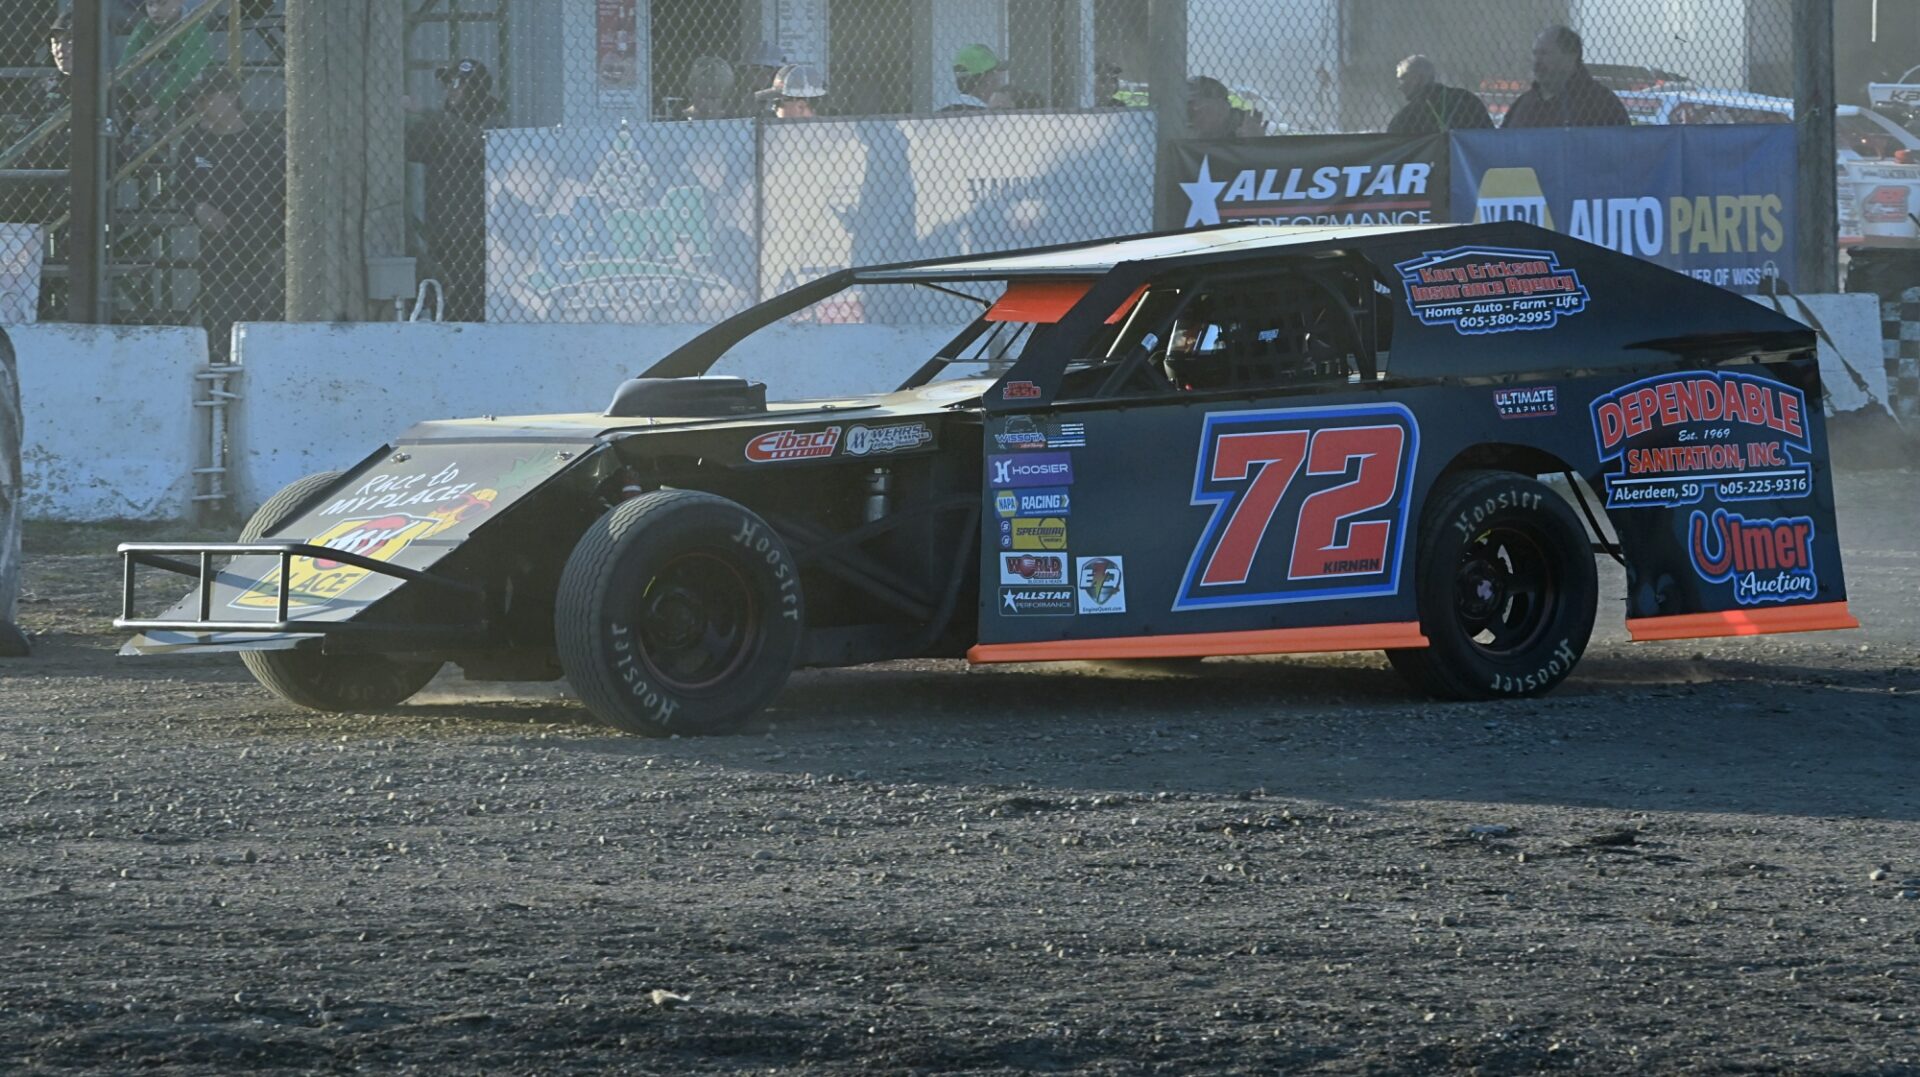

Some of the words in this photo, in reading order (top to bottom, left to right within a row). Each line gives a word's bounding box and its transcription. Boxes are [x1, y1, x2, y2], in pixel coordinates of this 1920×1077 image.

[1223, 163, 1431, 202] ALLSTAR
[1569, 197, 1663, 256] AUTO
[1670, 194, 1784, 254] PARTS
[1419, 263, 1468, 283] Kory
[1467, 260, 1548, 280] Erickson
[1714, 268, 1730, 286] OF
[1411, 281, 1505, 302] Insurance
[1505, 275, 1575, 295] Agency
[1425, 306, 1463, 318] Home
[1473, 303, 1503, 314] Auto
[1513, 299, 1547, 311] Farm
[1556, 296, 1579, 307] Life
[1460, 310, 1551, 328] 605-380-2995
[1496, 389, 1554, 405] ULTIMATE
[1501, 403, 1555, 414] GRAPHICS
[1598, 379, 1803, 448] DEPENDABLE
[872, 424, 923, 438] WEHRS
[995, 432, 1046, 444] WISSOTA
[1678, 430, 1698, 442] Est.
[1703, 428, 1731, 440] 1969
[746, 428, 838, 460] Eibach
[1012, 463, 1069, 476] HOOSIER
[1628, 444, 1746, 474] SANITATION,
[1748, 442, 1785, 467] INC.
[427, 462, 459, 487] to
[318, 496, 378, 517] MY
[367, 482, 477, 510] PLACE!
[1614, 484, 1679, 501] Aberdeen,
[1681, 483, 1699, 496] SD
[1720, 478, 1807, 495] 605-225-9316
[997, 496, 1018, 512] NAPA
[1021, 494, 1061, 511] RACING
[1200, 424, 1405, 586] 72
[1454, 489, 1543, 544] Hoosier
[1016, 526, 1065, 537] SPEEDWAY
[1694, 516, 1809, 575] Ulmer
[731, 518, 799, 621] Hoosier
[1323, 558, 1380, 574] KIRNAN
[1015, 591, 1071, 600] ALLSTAR
[1740, 572, 1811, 596] Auction
[612, 622, 680, 725] Hoosier
[1491, 638, 1576, 693] Hoosier
